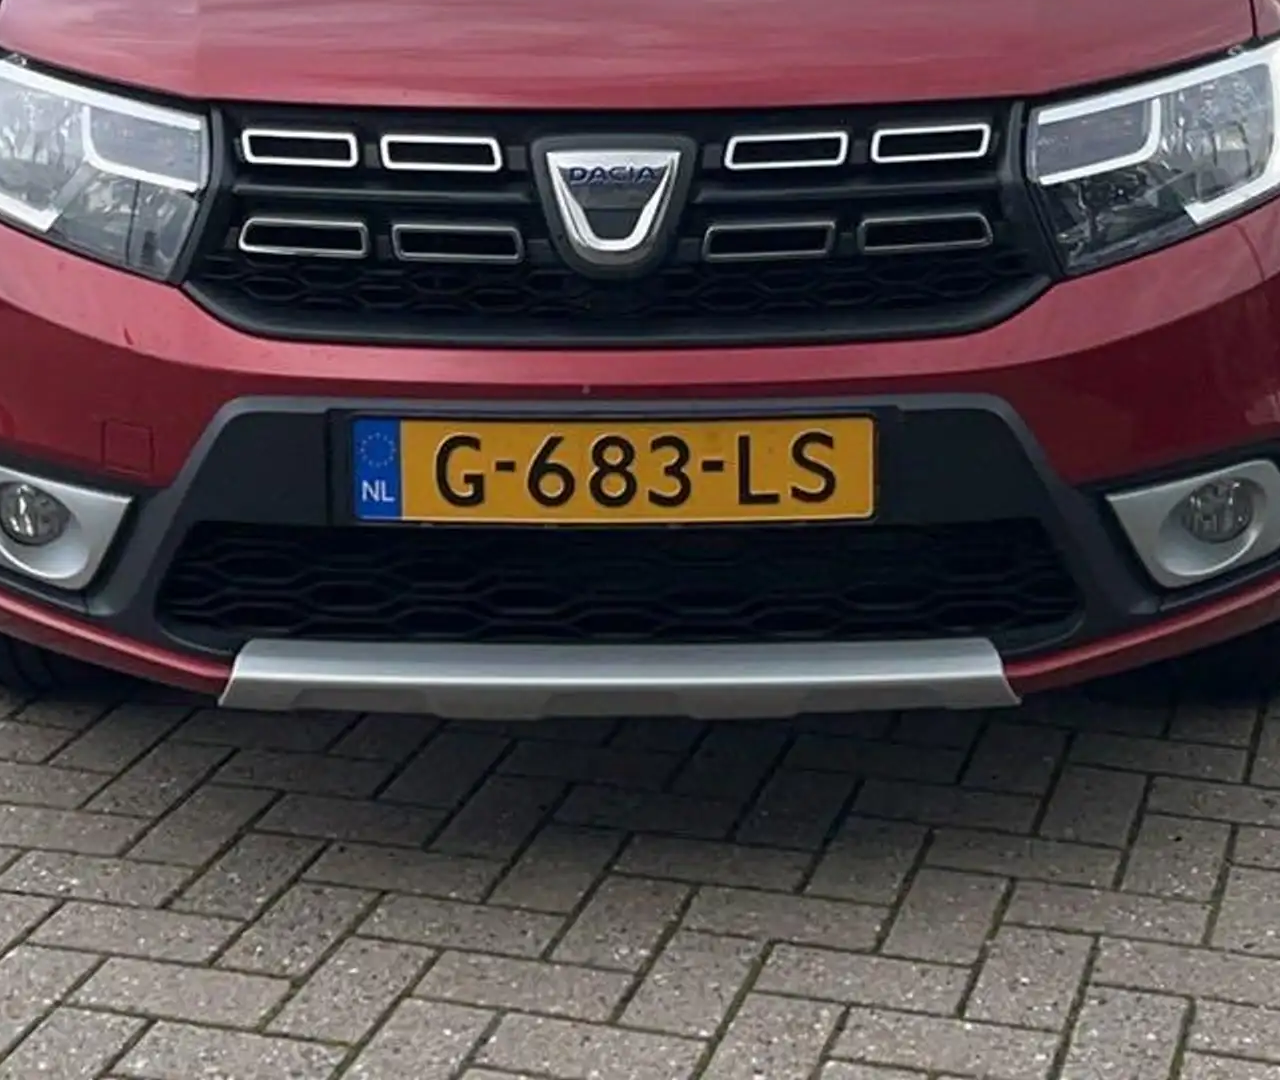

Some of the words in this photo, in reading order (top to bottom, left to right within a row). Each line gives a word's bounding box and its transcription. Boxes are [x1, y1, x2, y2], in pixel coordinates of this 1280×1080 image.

[569, 166, 656, 185] DACIA
[434, 430, 837, 508] G-683-LS
[361, 480, 395, 504] NL
